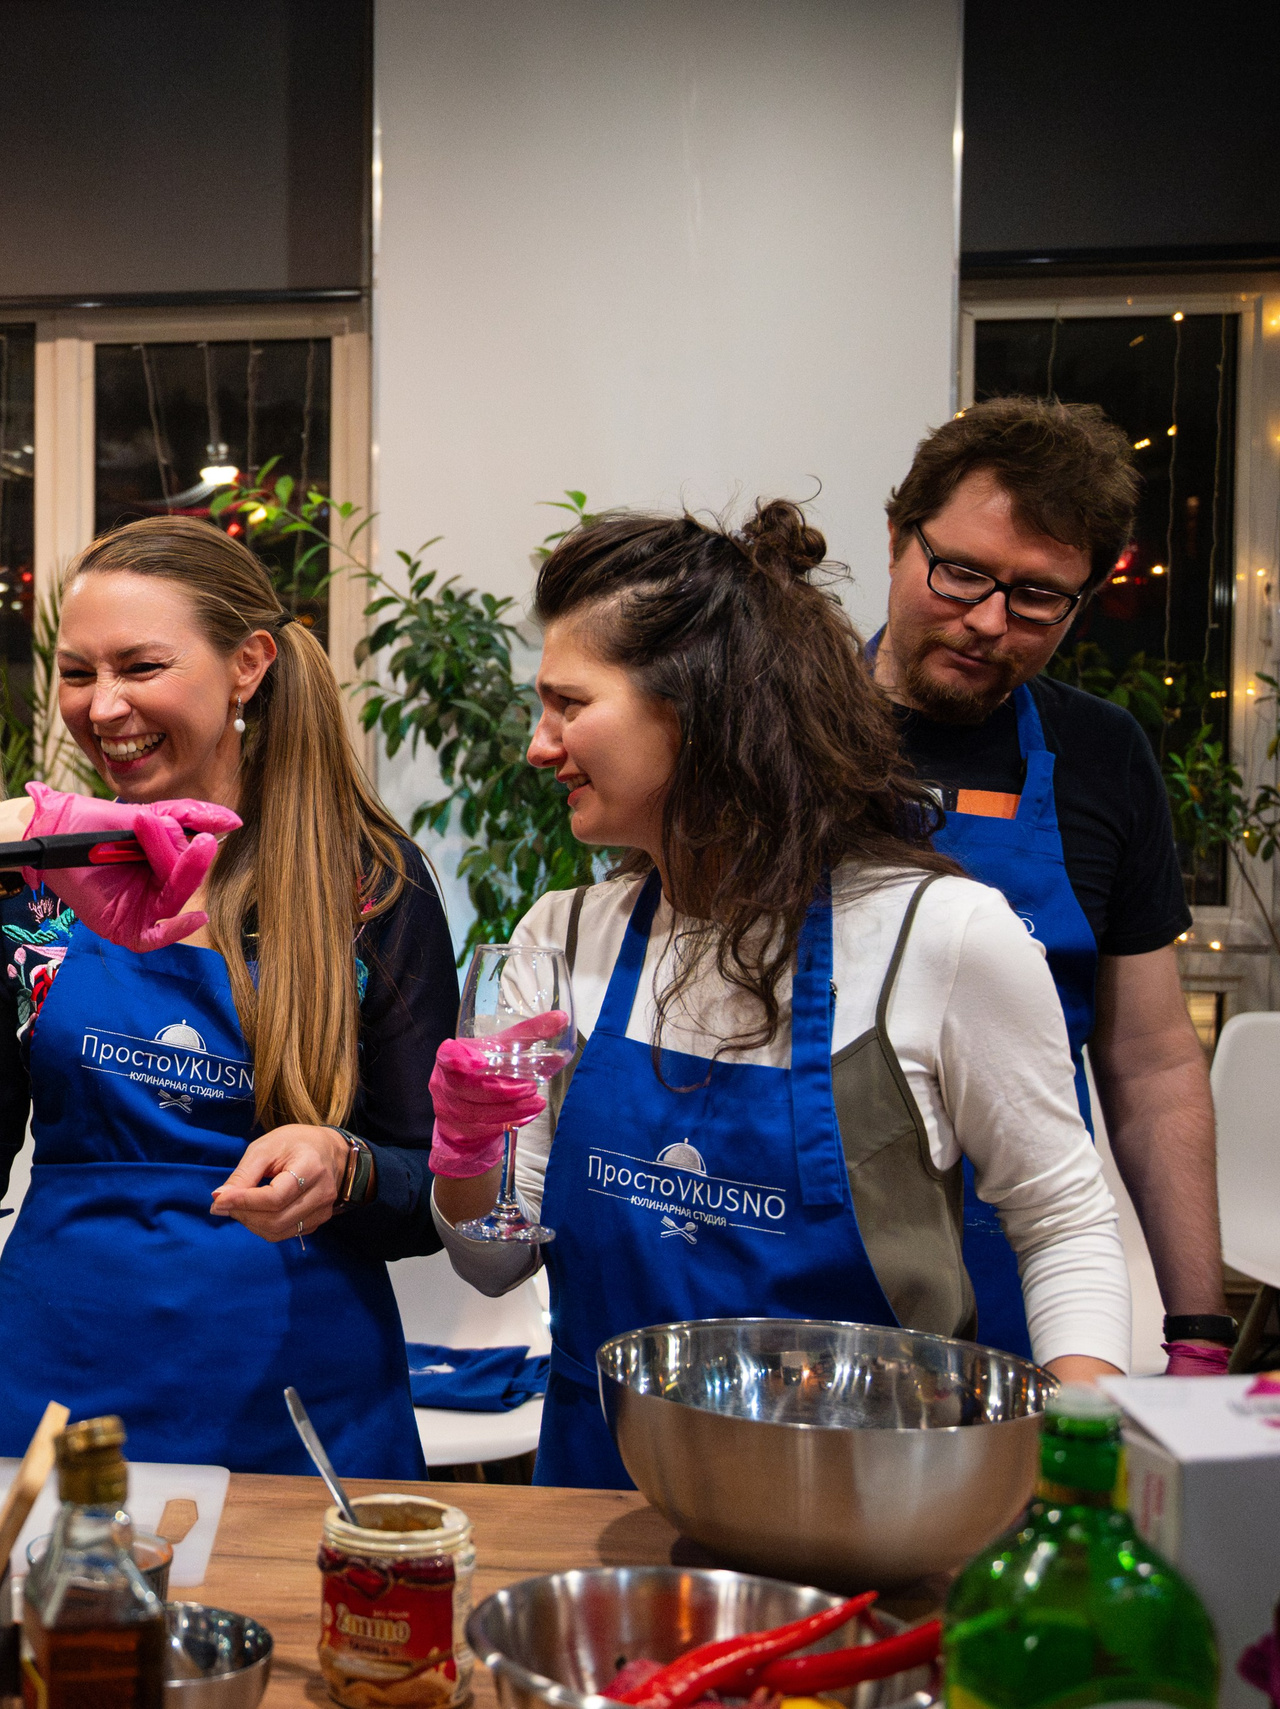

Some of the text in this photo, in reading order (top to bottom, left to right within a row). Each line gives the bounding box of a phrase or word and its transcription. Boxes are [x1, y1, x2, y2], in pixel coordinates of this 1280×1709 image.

[81, 1034, 255, 1091] ПростоVKUSN
[129, 1071, 224, 1099] КУЛИНАРНАЯ СТУДИЯ
[588, 1155, 786, 1220] ПростоVKUSNO
[630, 1194, 727, 1227] КУЛИНАРНАЯ СТУДИЯ
